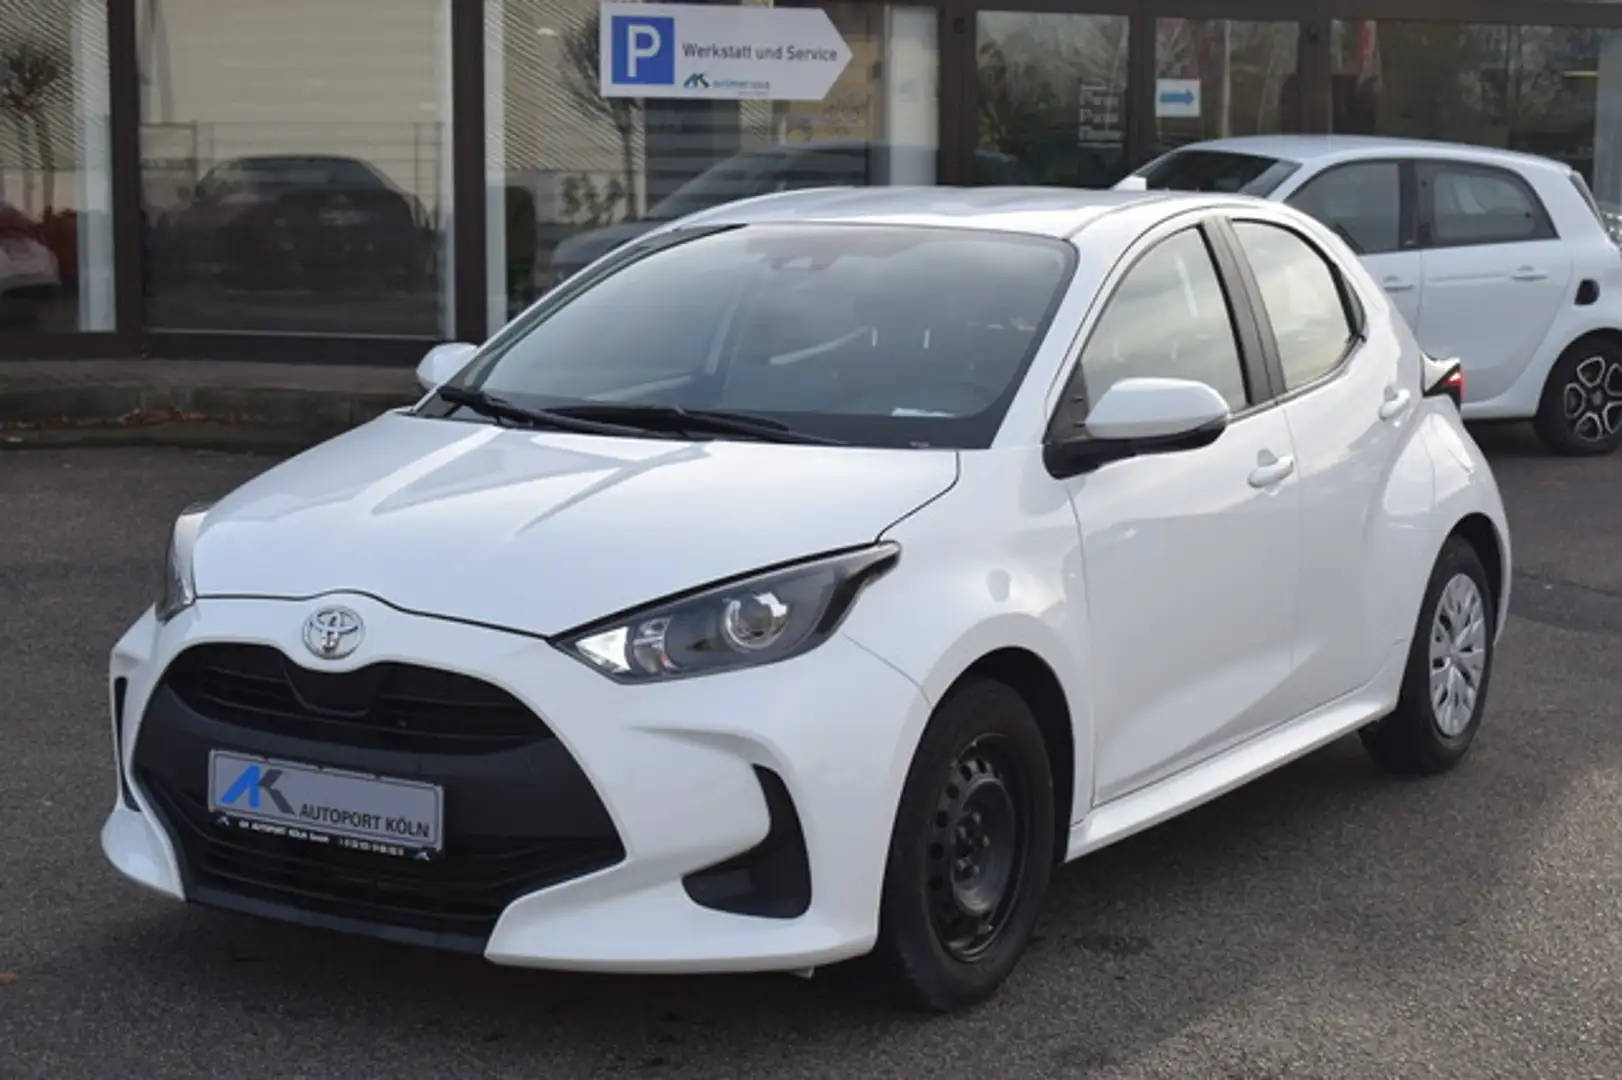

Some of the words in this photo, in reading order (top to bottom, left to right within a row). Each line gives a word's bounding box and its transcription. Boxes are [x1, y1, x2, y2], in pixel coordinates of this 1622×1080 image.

[626, 24, 661, 78] P
[682, 42, 752, 60] Werkstatt
[756, 44, 783, 61] und
[787, 45, 838, 63] Service
[299, 803, 384, 830] AUTOPORT
[385, 816, 431, 838] KÖLN
